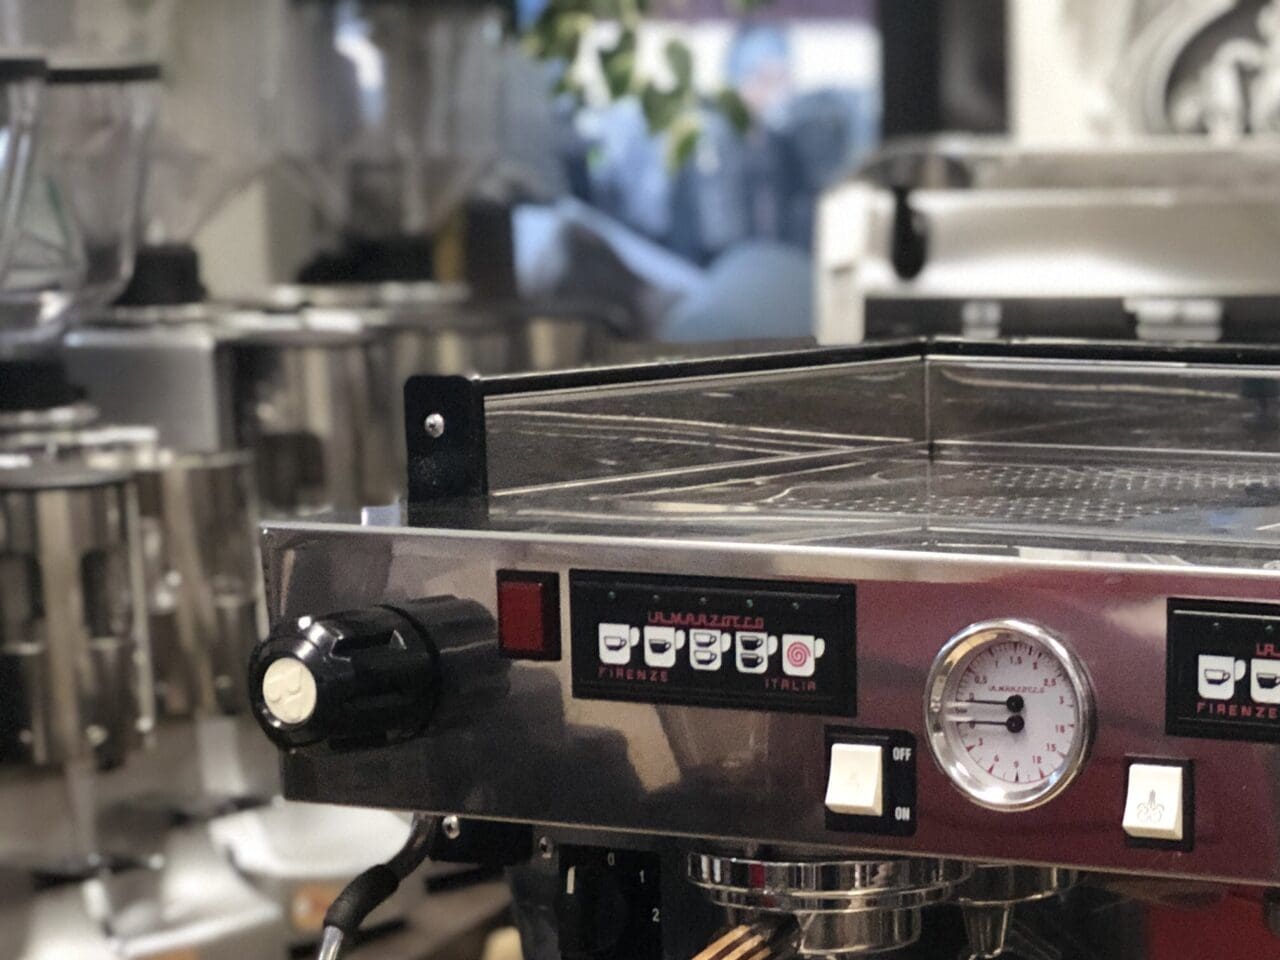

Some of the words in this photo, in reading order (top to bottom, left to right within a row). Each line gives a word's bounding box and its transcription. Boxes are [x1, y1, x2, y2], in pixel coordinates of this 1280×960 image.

[597, 667, 669, 683] FIRENZE
[765, 678, 817, 691] ITALIA
[1197, 703, 1278, 719] FIRENZE
[892, 746, 912, 761] OFF
[894, 806, 911, 821] ON
[639, 869, 645, 883] 1
[651, 907, 660, 922] 2
